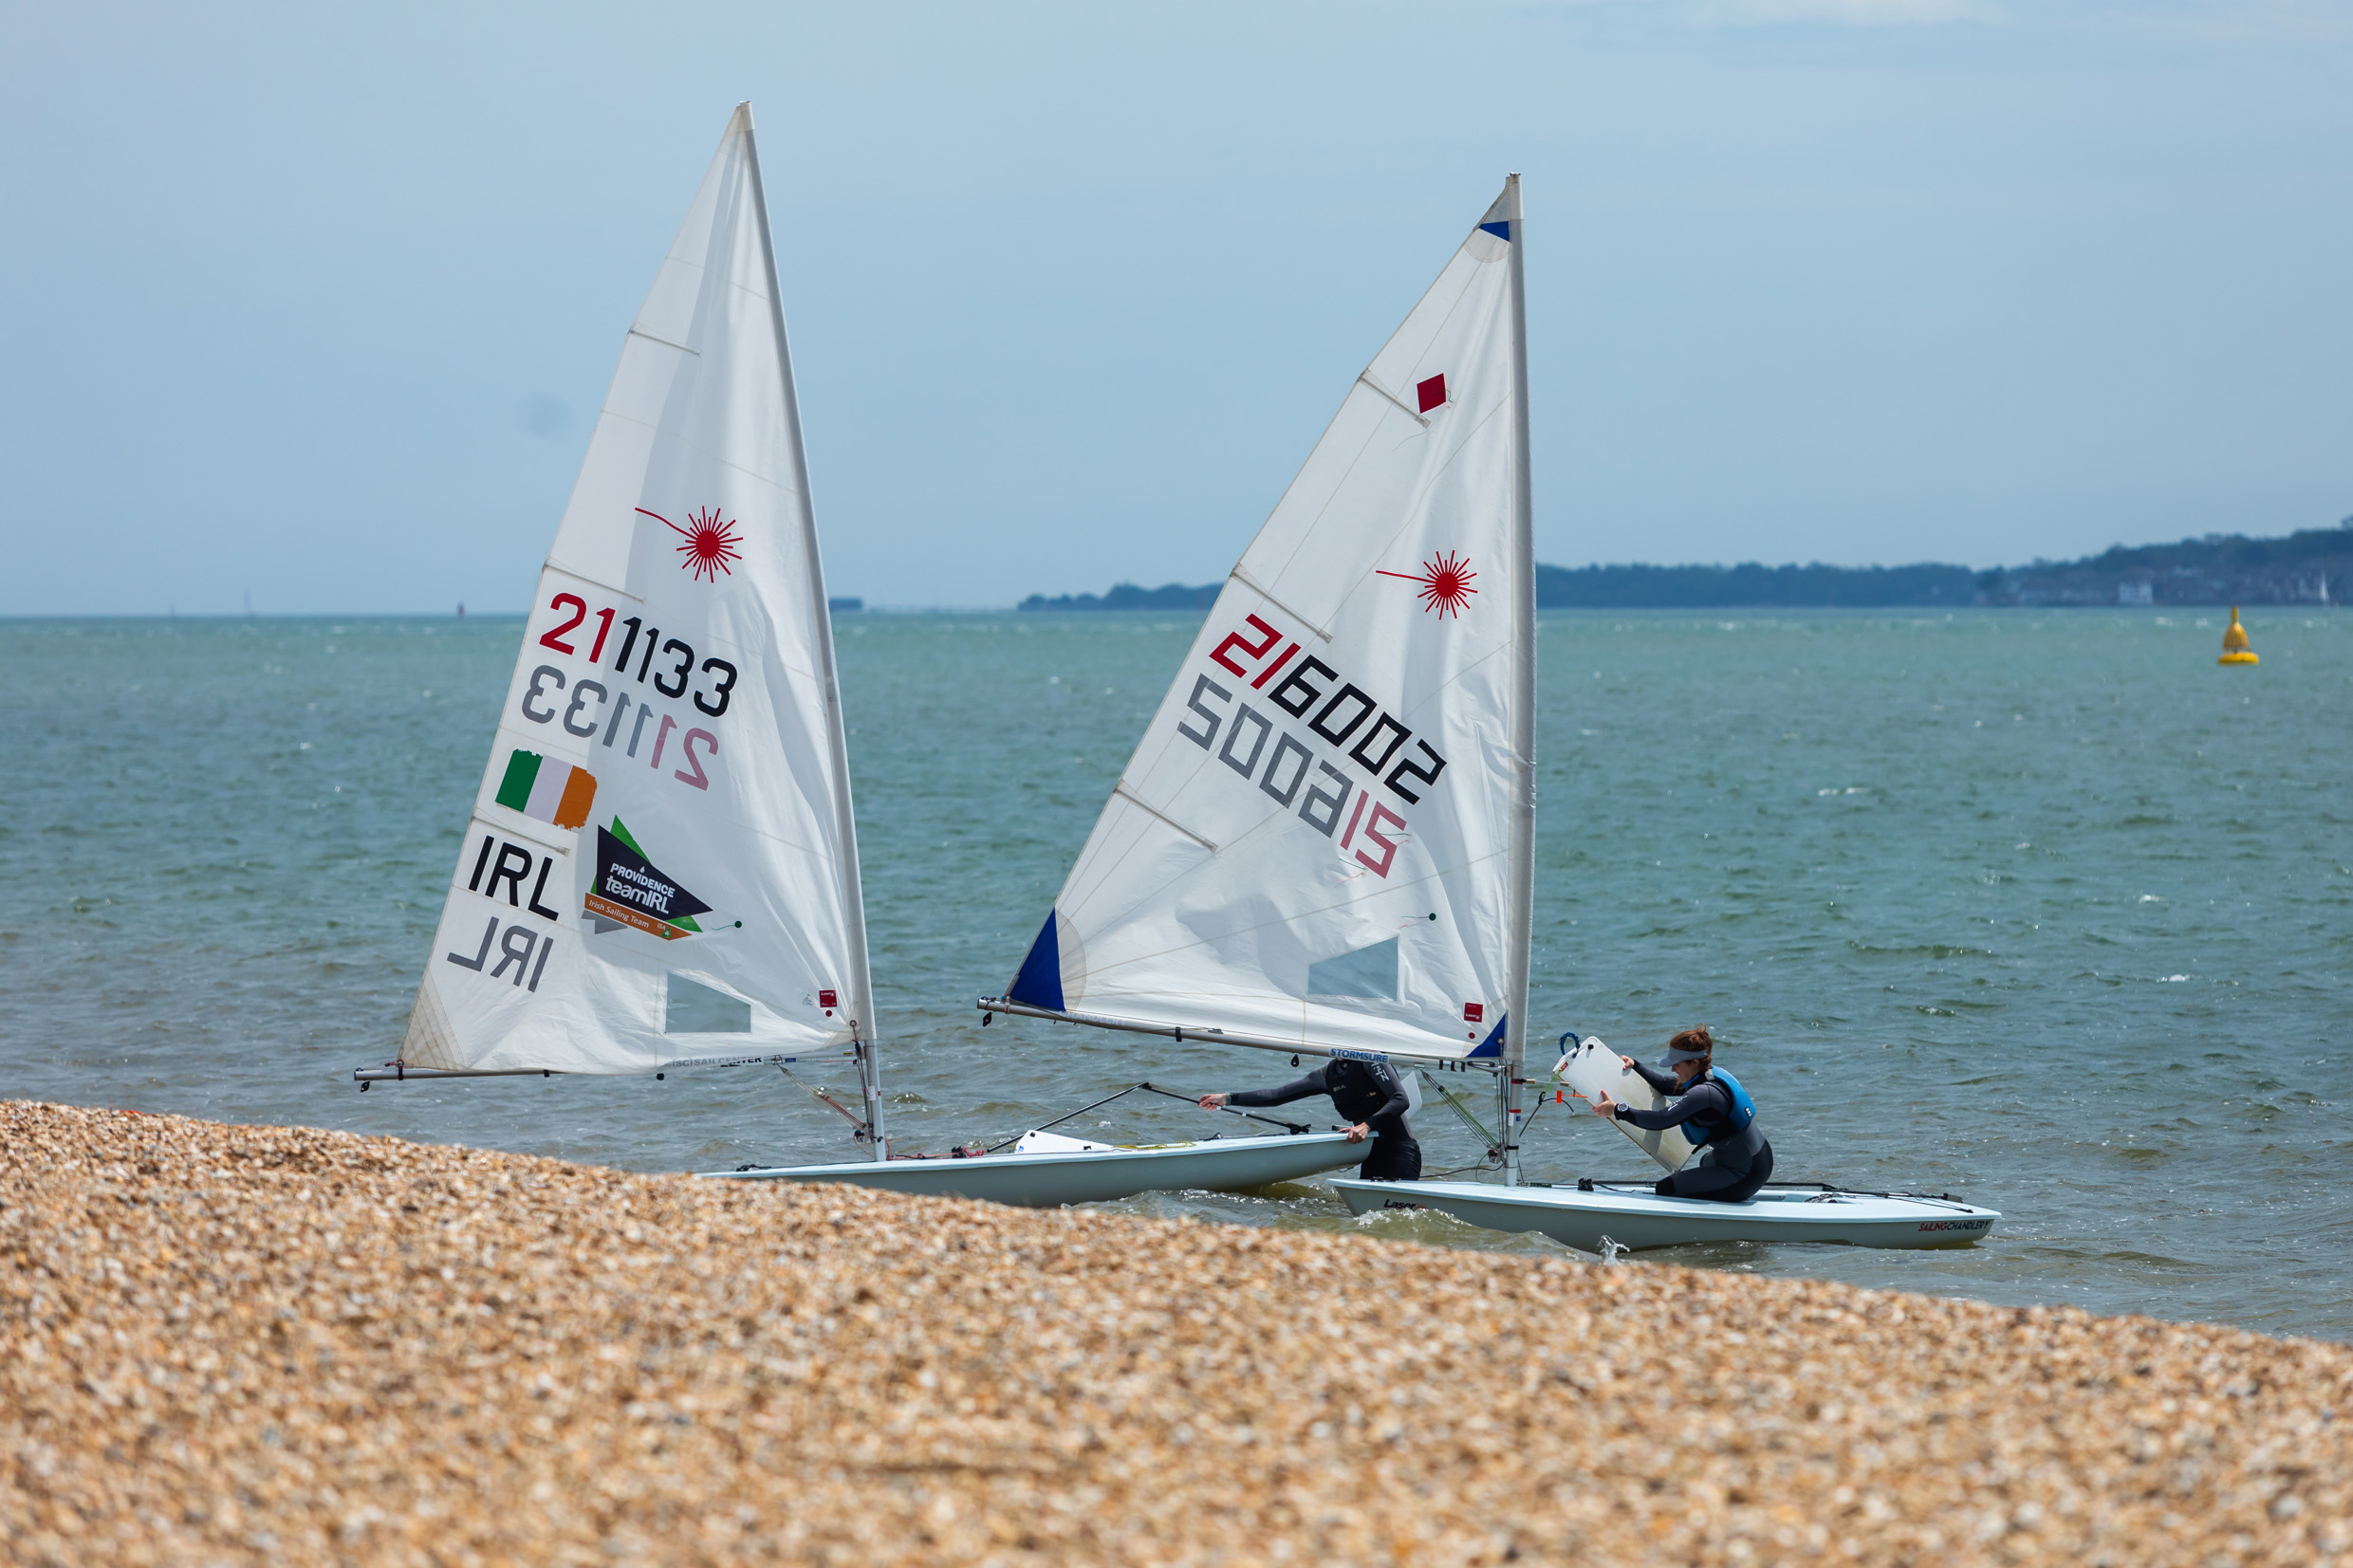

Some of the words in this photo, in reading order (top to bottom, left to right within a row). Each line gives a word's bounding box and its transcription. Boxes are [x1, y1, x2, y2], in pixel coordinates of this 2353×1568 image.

[539, 592, 738, 717] 211133
[1208, 613, 1447, 805] 216002
[468, 835, 559, 921] IRL
[605, 875, 669, 914] teamIRL
[610, 862, 676, 898] PROVIDENCE
[588, 899, 604, 911] Irish
[605, 906, 628, 921] Sailing
[630, 914, 650, 928] Team
[1330, 1048, 1388, 1063] STORMSURE
[1383, 1198, 1417, 1209] Laser
